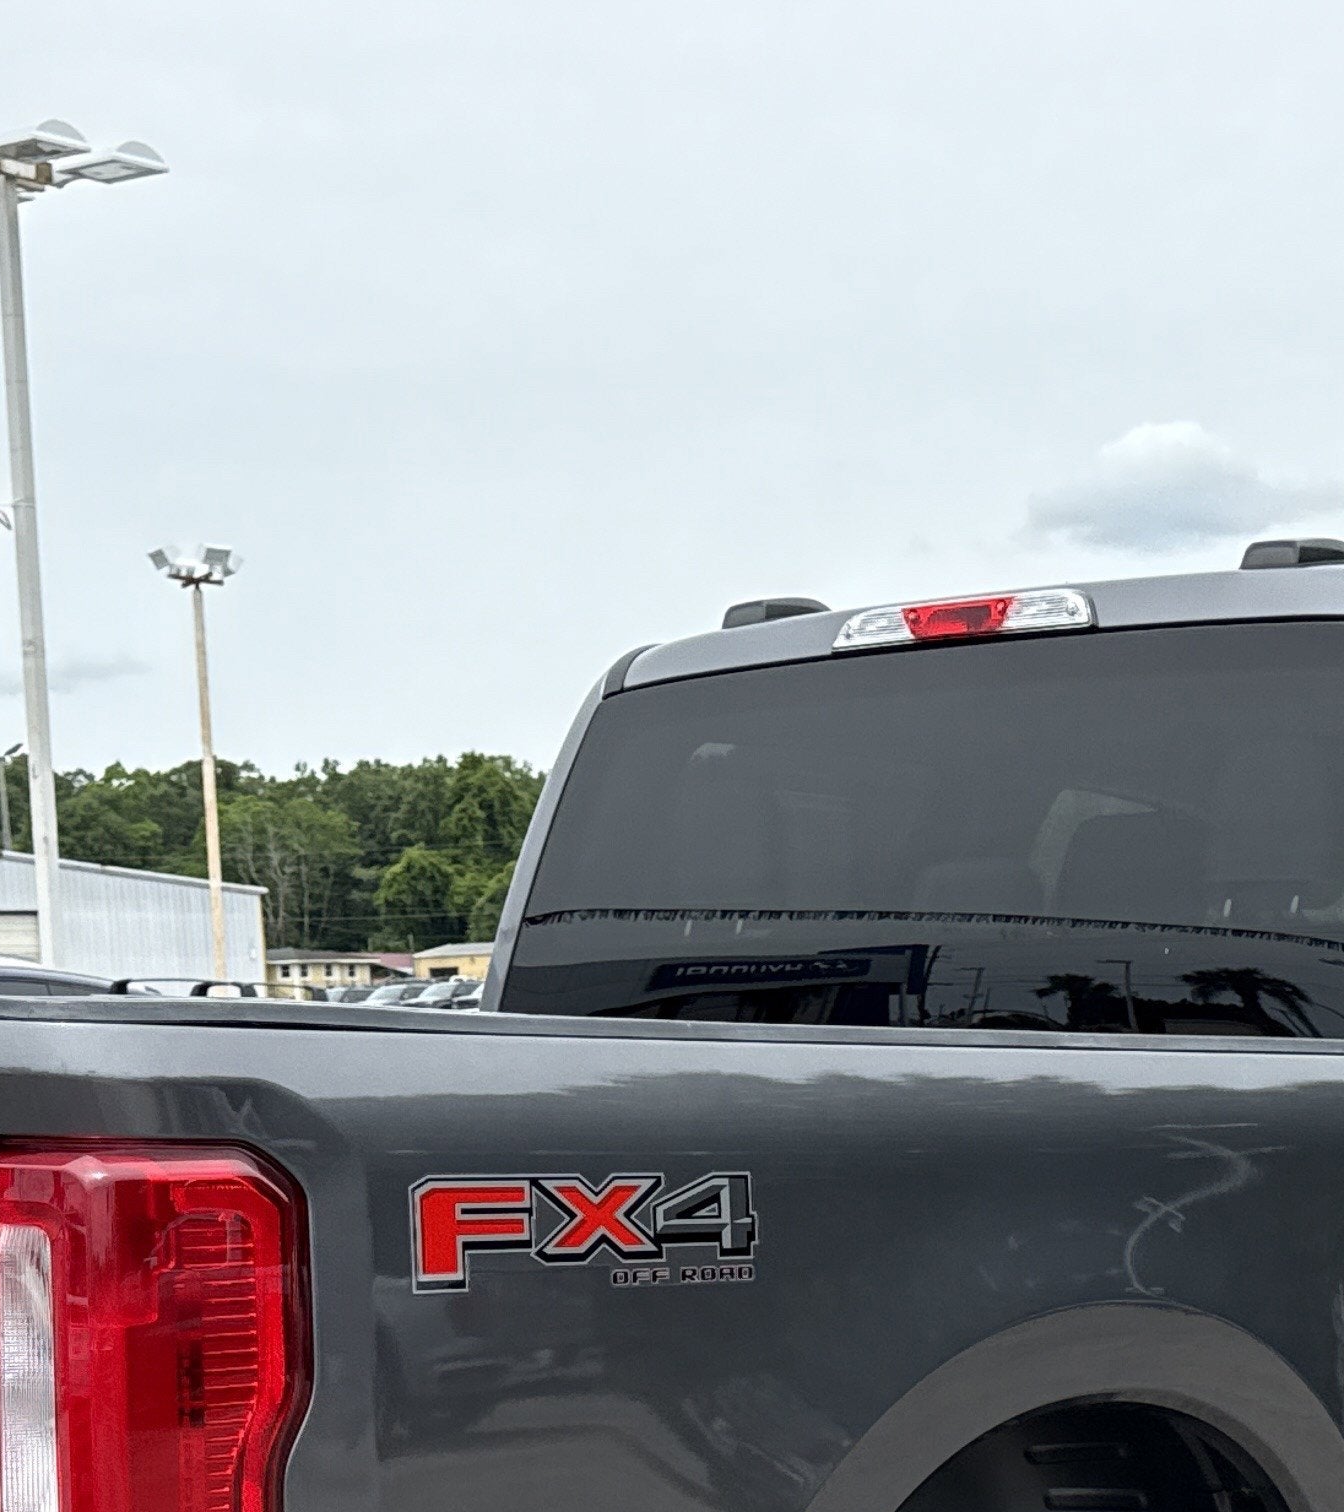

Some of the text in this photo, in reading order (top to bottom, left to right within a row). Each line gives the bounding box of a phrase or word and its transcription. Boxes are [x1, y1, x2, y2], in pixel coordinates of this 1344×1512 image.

[408, 1172, 759, 1295] FX4
[610, 1264, 754, 1286] OFF ROAD
